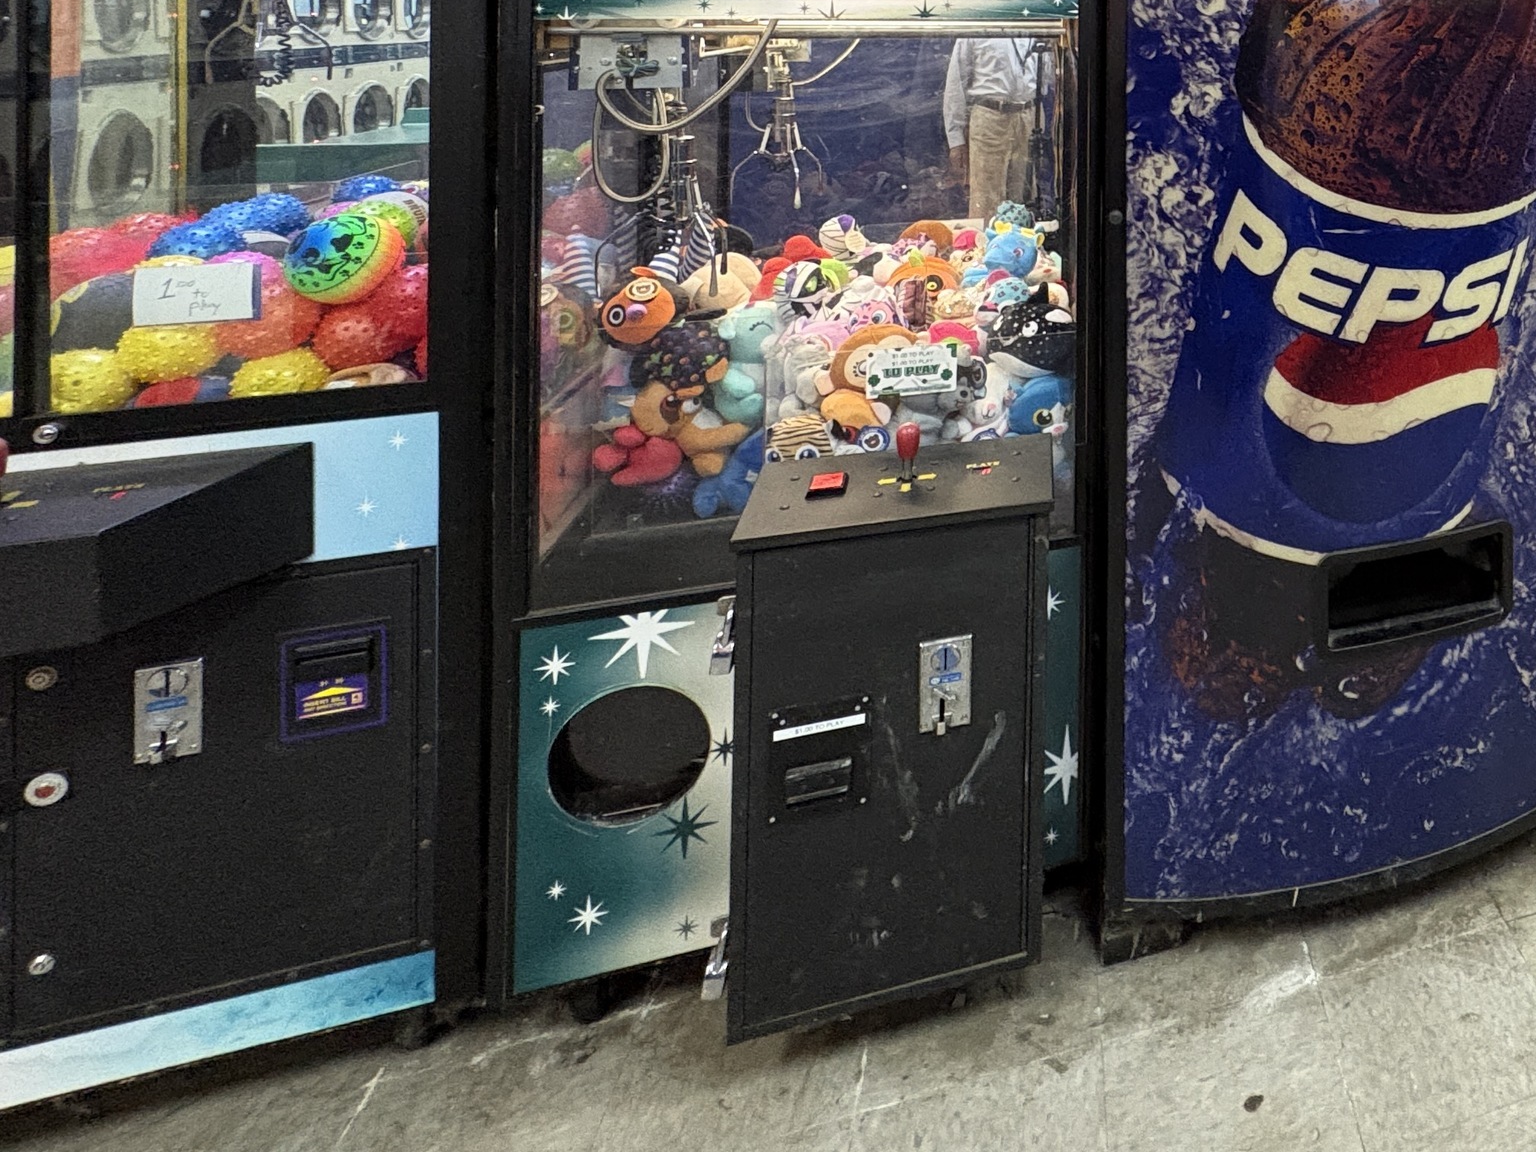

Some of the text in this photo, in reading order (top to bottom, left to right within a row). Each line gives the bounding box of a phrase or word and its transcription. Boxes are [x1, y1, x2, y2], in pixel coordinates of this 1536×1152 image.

[1212, 188, 1530, 345] PEPSI
[192, 288, 210, 298] to
[188, 300, 222, 317] play
[882, 364, 941, 379] TO PLAY
[794, 726, 814, 735] $1.00
[826, 720, 845, 728] PLAY
